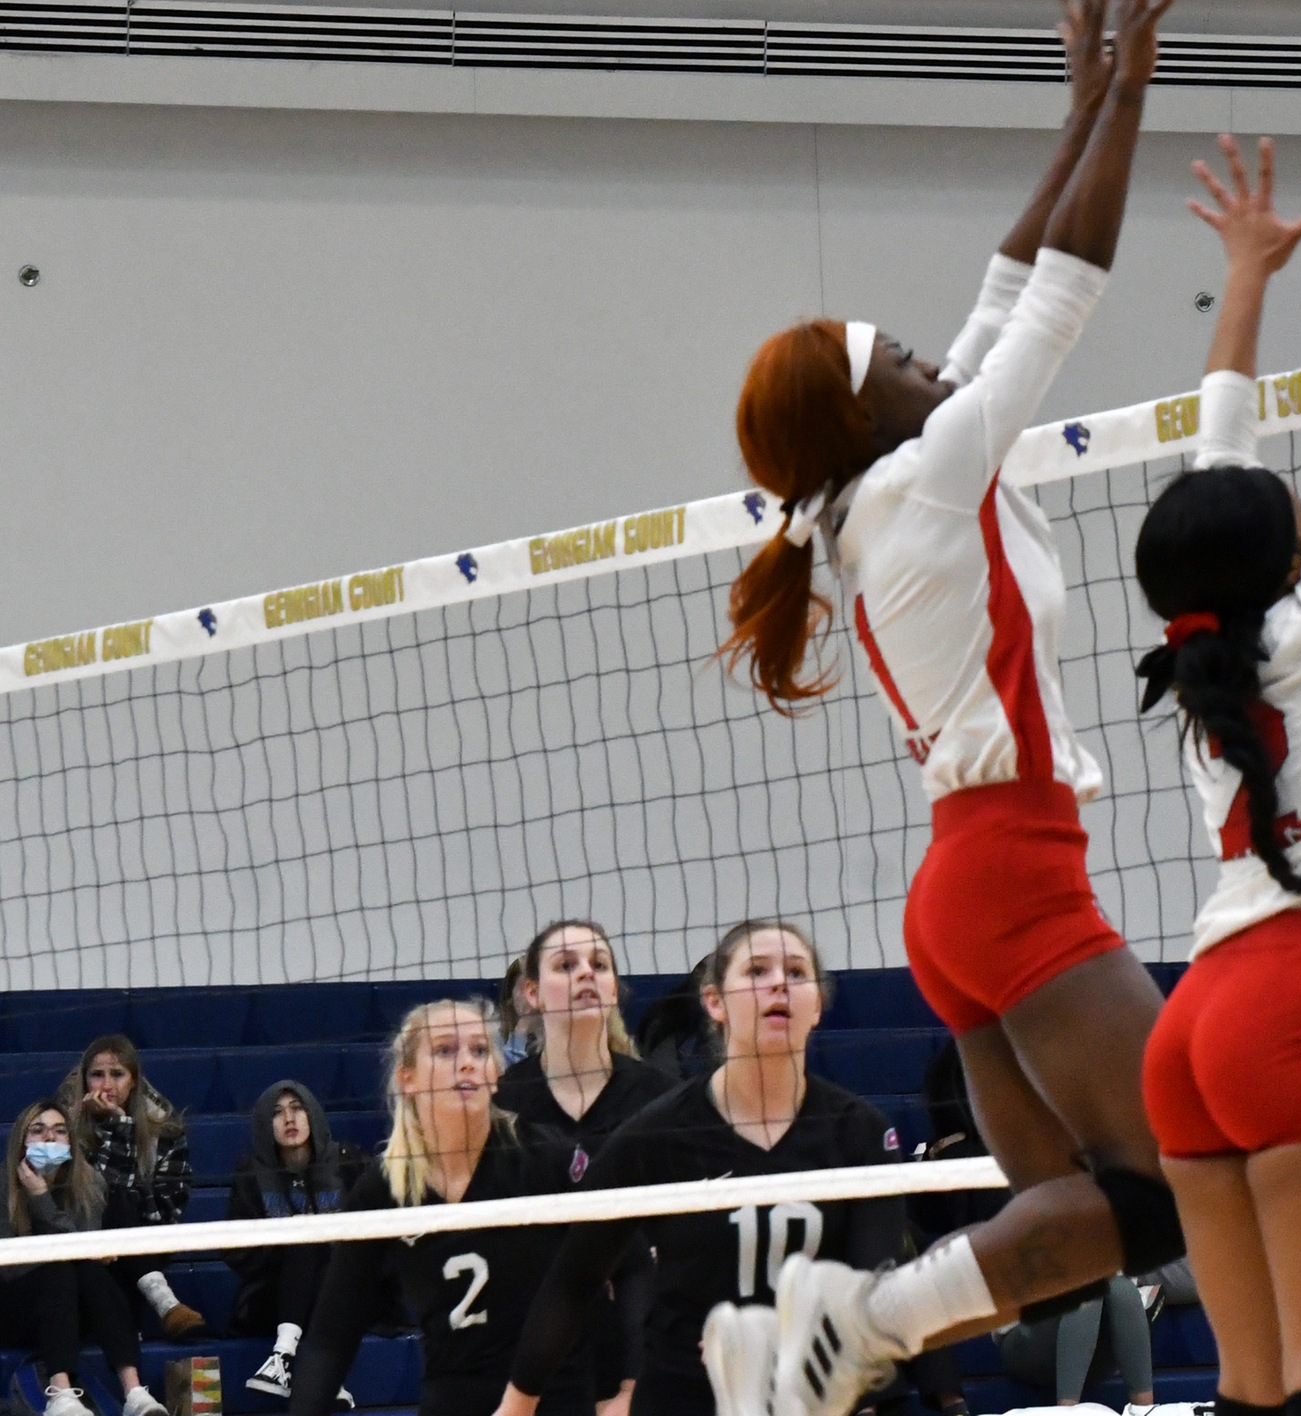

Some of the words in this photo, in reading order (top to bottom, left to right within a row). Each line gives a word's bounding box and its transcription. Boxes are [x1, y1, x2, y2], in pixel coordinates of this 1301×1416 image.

[529, 520, 617, 575] GEORGIAN
[623, 505, 686, 555] COURT
[728, 1201, 823, 1298] 10
[442, 1252, 489, 1331] 2
